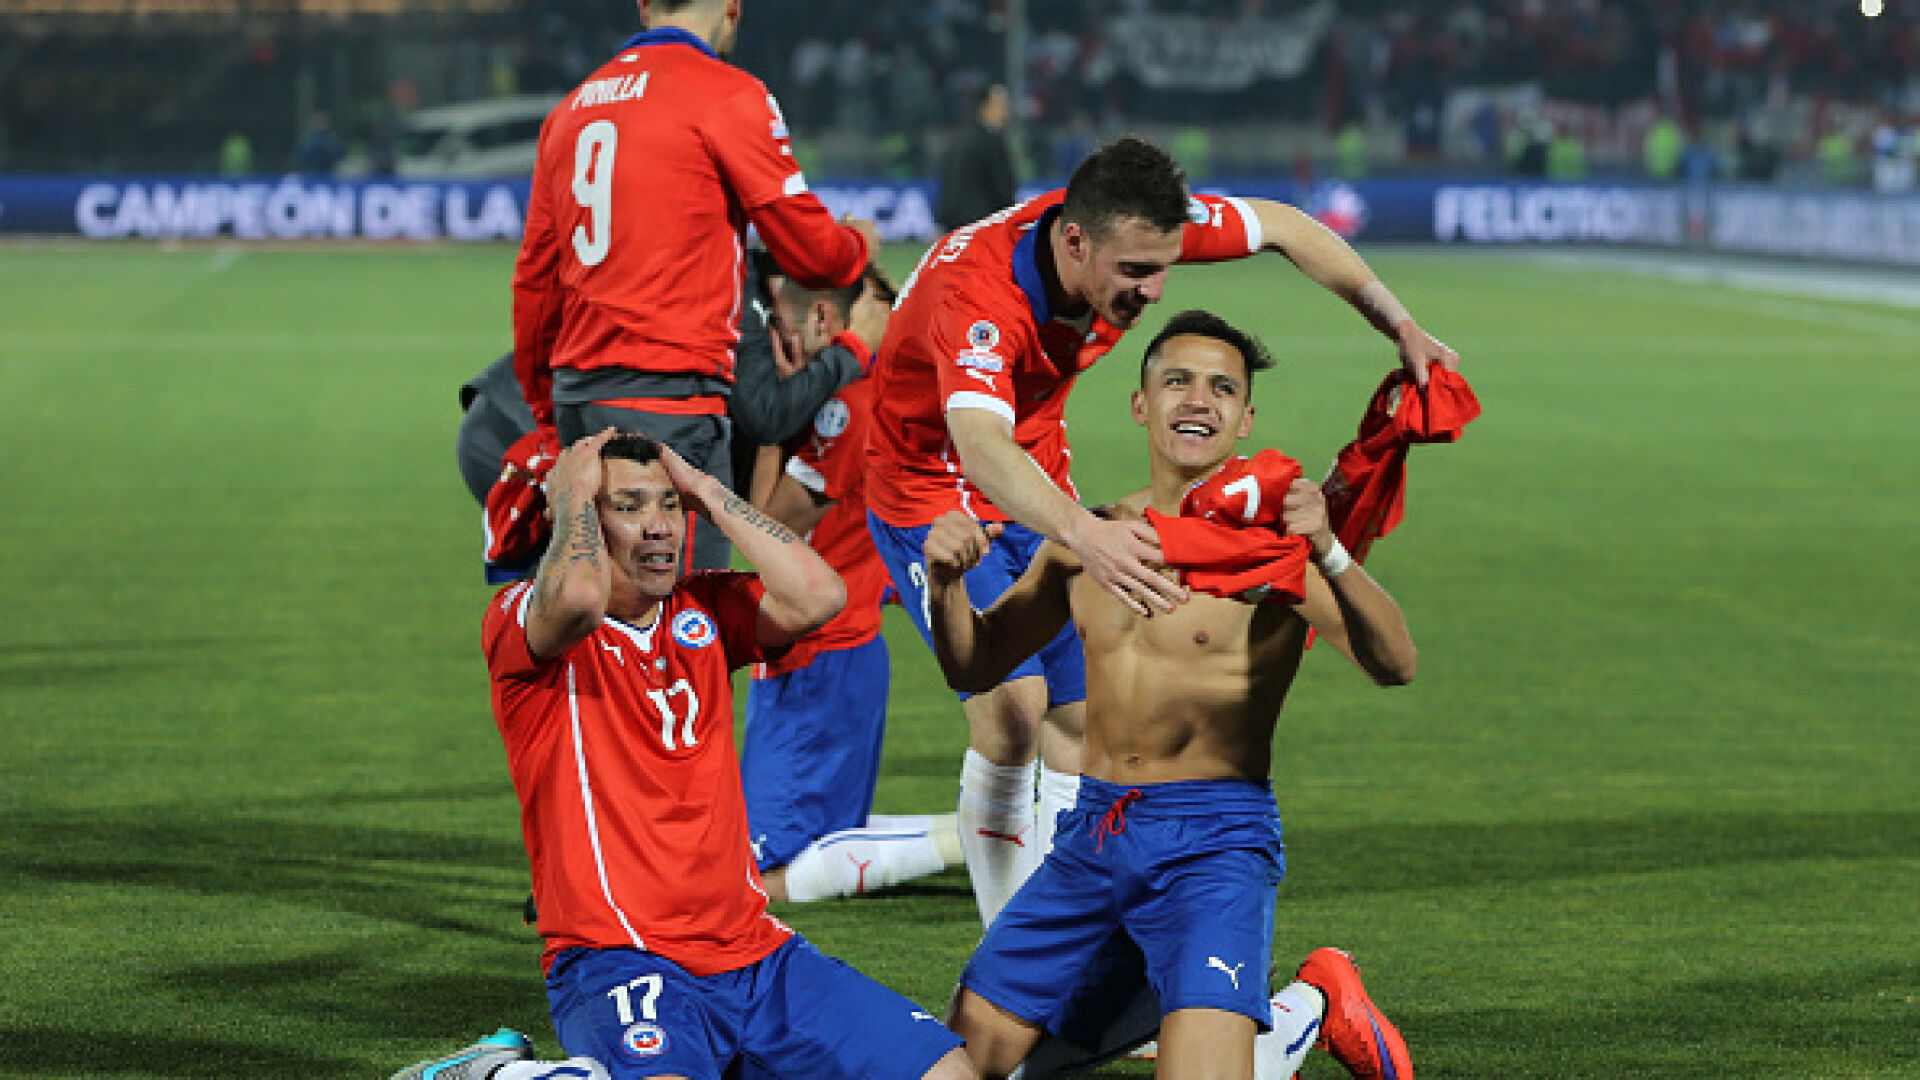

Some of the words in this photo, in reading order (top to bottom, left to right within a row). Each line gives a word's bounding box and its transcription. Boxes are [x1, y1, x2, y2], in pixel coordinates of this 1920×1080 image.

[77, 176, 355, 239] CAMPEÓN
[362, 186, 440, 239] DE
[446, 186, 523, 239] LA
[571, 119, 618, 266] 9
[1222, 474, 1262, 521] 7
[646, 678, 699, 751] 17
[607, 973, 664, 1025] 17
